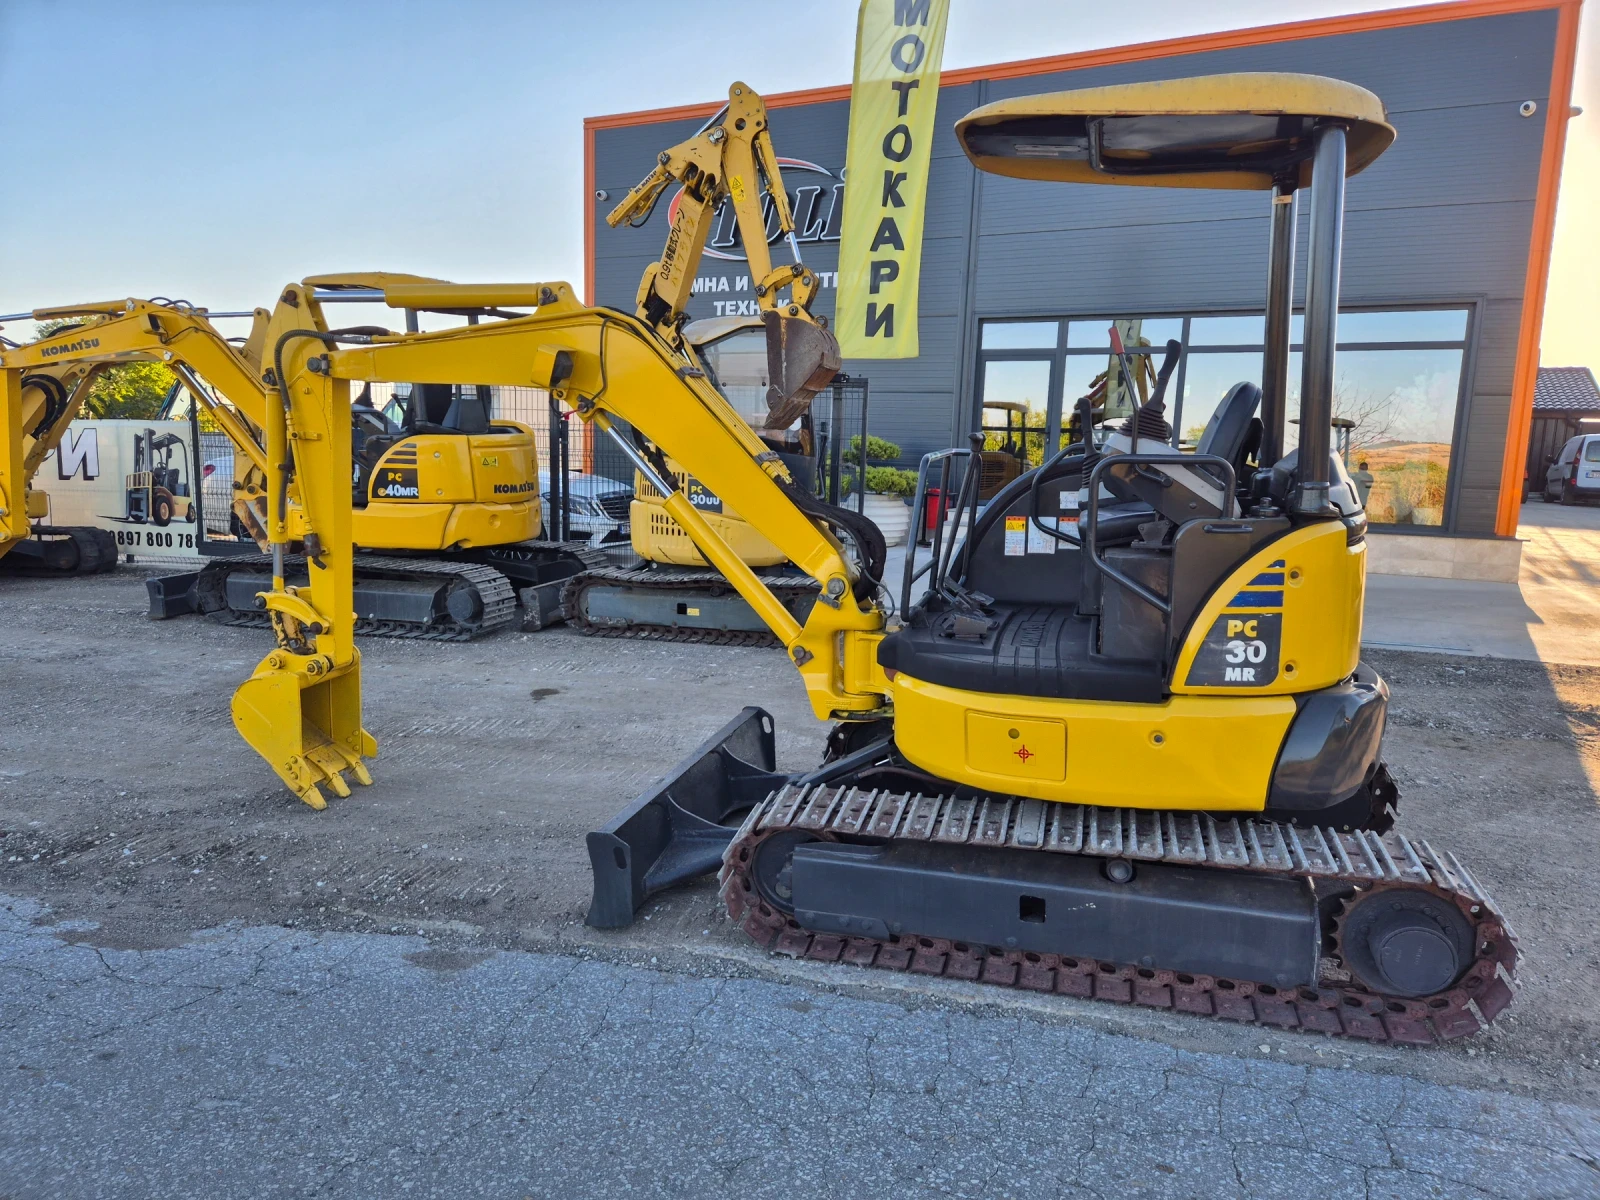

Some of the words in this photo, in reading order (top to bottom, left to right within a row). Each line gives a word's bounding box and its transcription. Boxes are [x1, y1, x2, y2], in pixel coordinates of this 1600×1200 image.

[41, 338, 100, 357] KOMATSU
[387, 472, 403, 481] PC
[385, 484, 419, 497] 40MR
[493, 480, 536, 494] KOMATSU
[691, 485, 703, 494] PC
[146, 532, 173, 547] 800
[1227, 619, 1258, 638] PC
[1225, 639, 1267, 664] 30
[1224, 667, 1256, 682] MR
